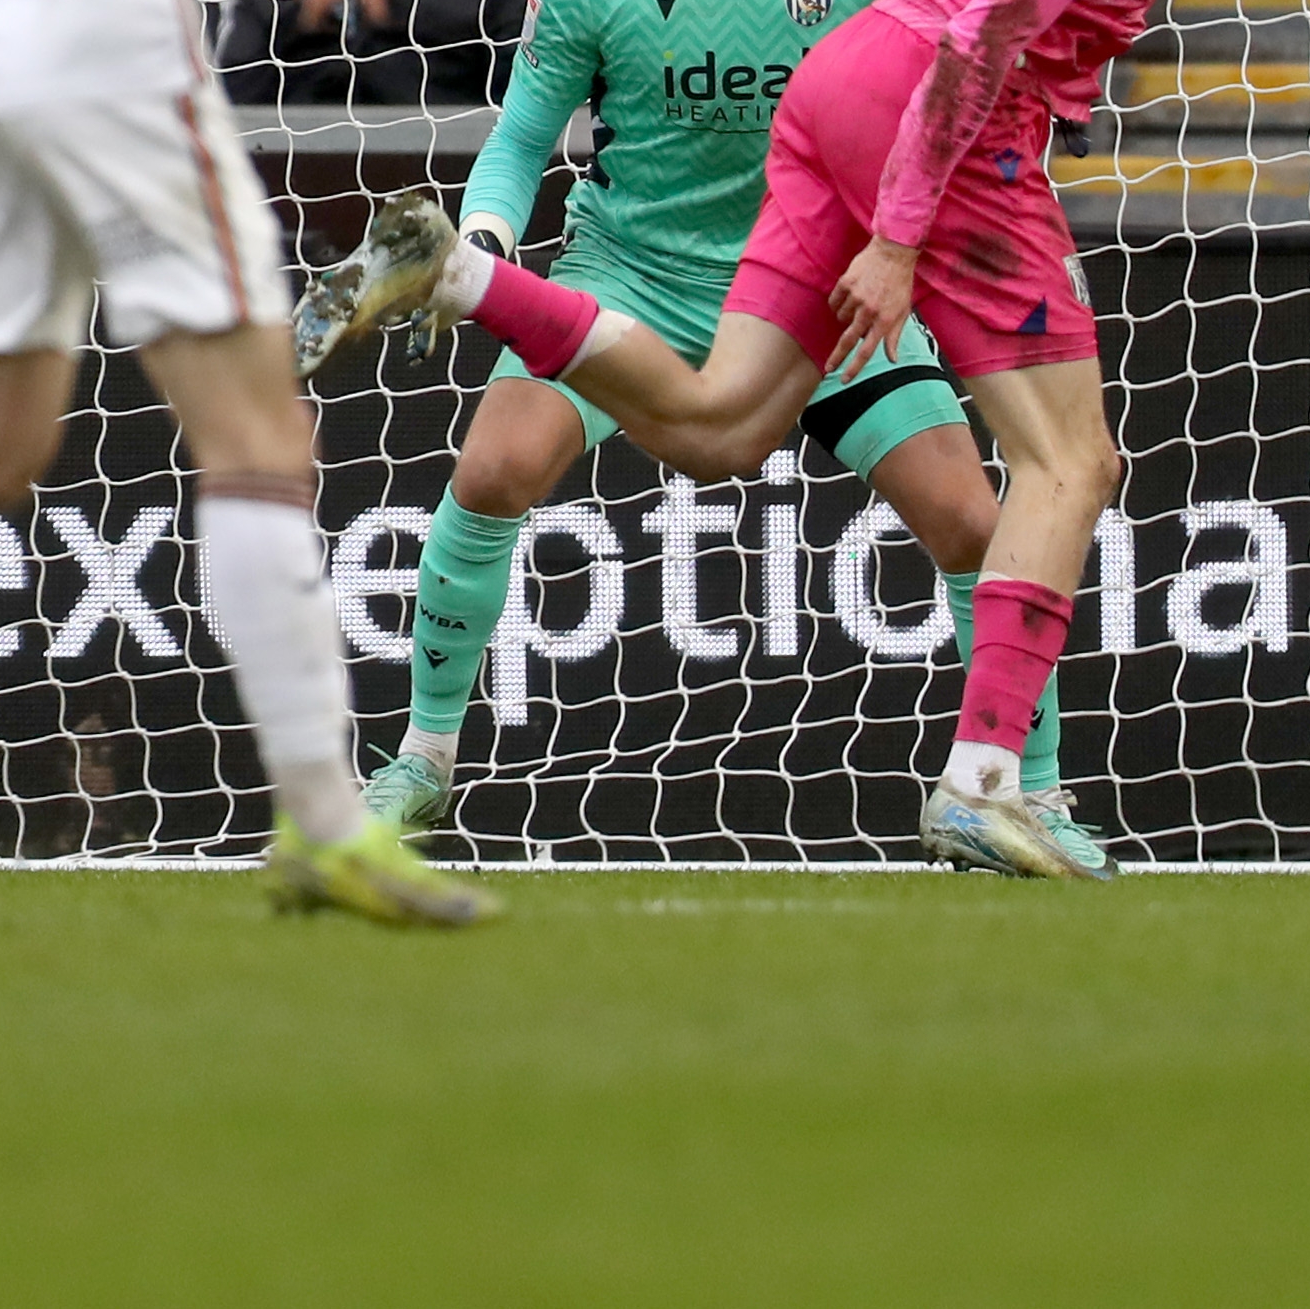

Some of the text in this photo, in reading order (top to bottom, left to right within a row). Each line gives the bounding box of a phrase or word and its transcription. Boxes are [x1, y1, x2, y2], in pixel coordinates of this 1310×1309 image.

[663, 47, 810, 101] idea
[666, 103, 778, 123] HEATI
[420, 604, 467, 630] WBA
